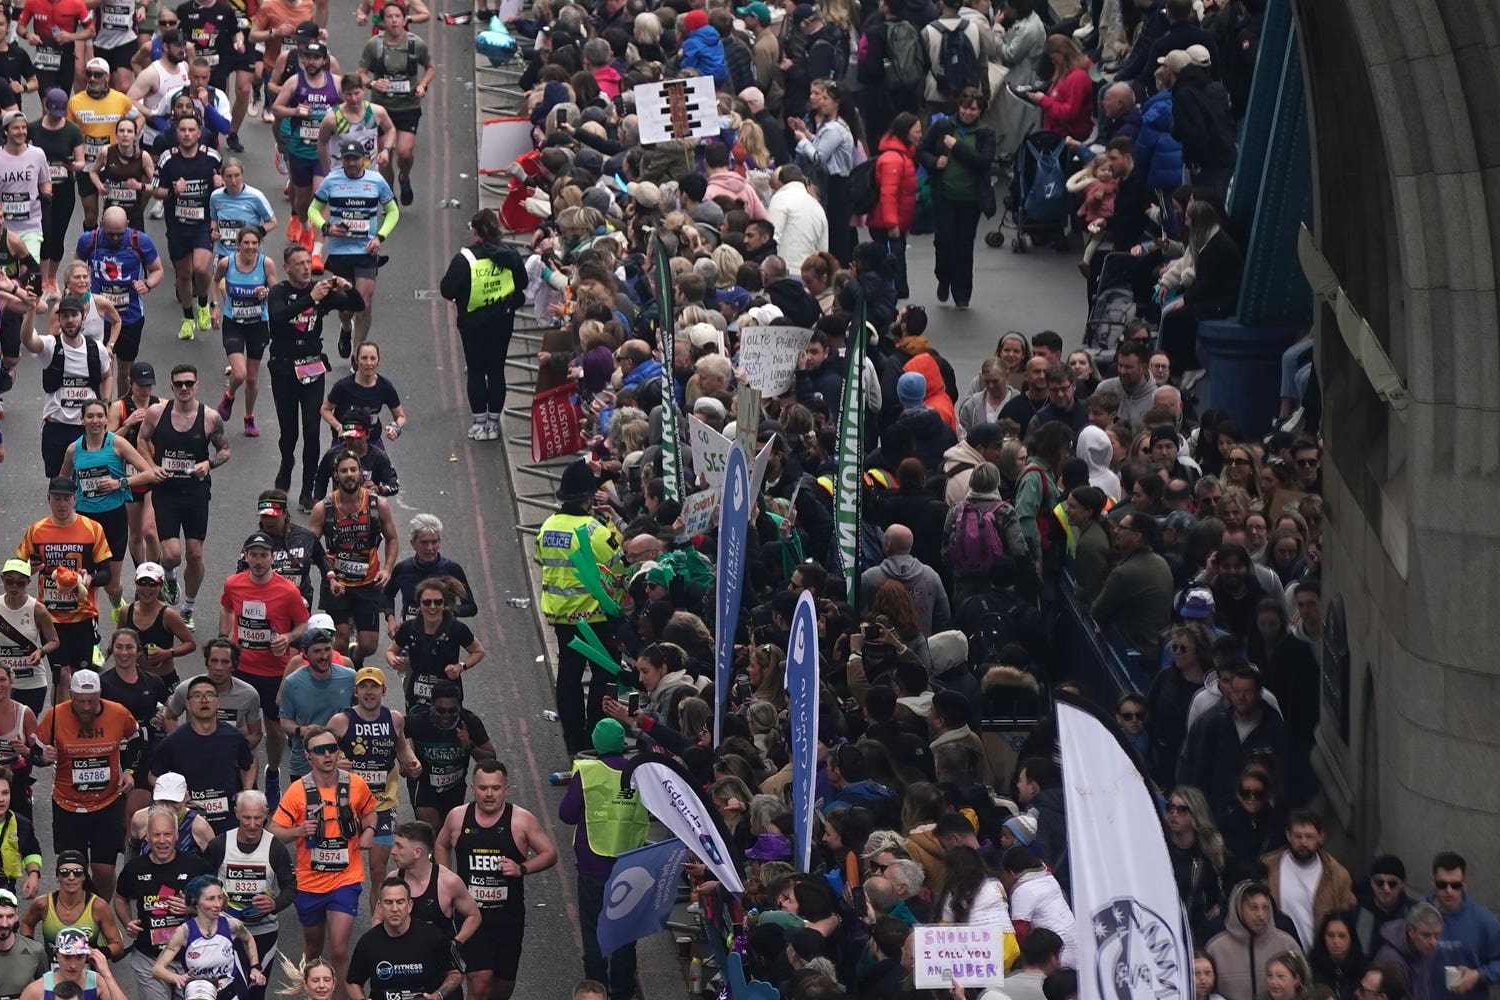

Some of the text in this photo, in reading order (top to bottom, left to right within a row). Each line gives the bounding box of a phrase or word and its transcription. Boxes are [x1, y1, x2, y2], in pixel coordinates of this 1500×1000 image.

[308, 94, 326, 102] BEN
[2, 170, 32, 182] JAKE
[345, 198, 365, 206] Joan
[234, 287, 255, 295] Than
[539, 402, 551, 438] TEAM
[548, 398, 562, 455] NOWDON
[335, 523, 368, 533] CHILDRE
[543, 536, 570, 547] POLICE
[45, 544, 83, 552] CHILDREN
[45, 552, 66, 560] WITH
[45, 558, 77, 567] CANCER
[244, 607, 264, 617] NEIL
[242, 630, 265, 641] 16409
[77, 726, 105, 740] ASH
[355, 722, 389, 736] DREW
[372, 738, 394, 747] Guide
[78, 770, 106, 781] 45786
[319, 852, 341, 862] 9574
[235, 882, 258, 892] 8323
[474, 890, 502, 899] 10445
[923, 930, 991, 945] SHOULD
[923, 949, 992, 960] I CALL YOU
[394, 963, 422, 971] FITNESS
[926, 963, 998, 978] AN UBER
